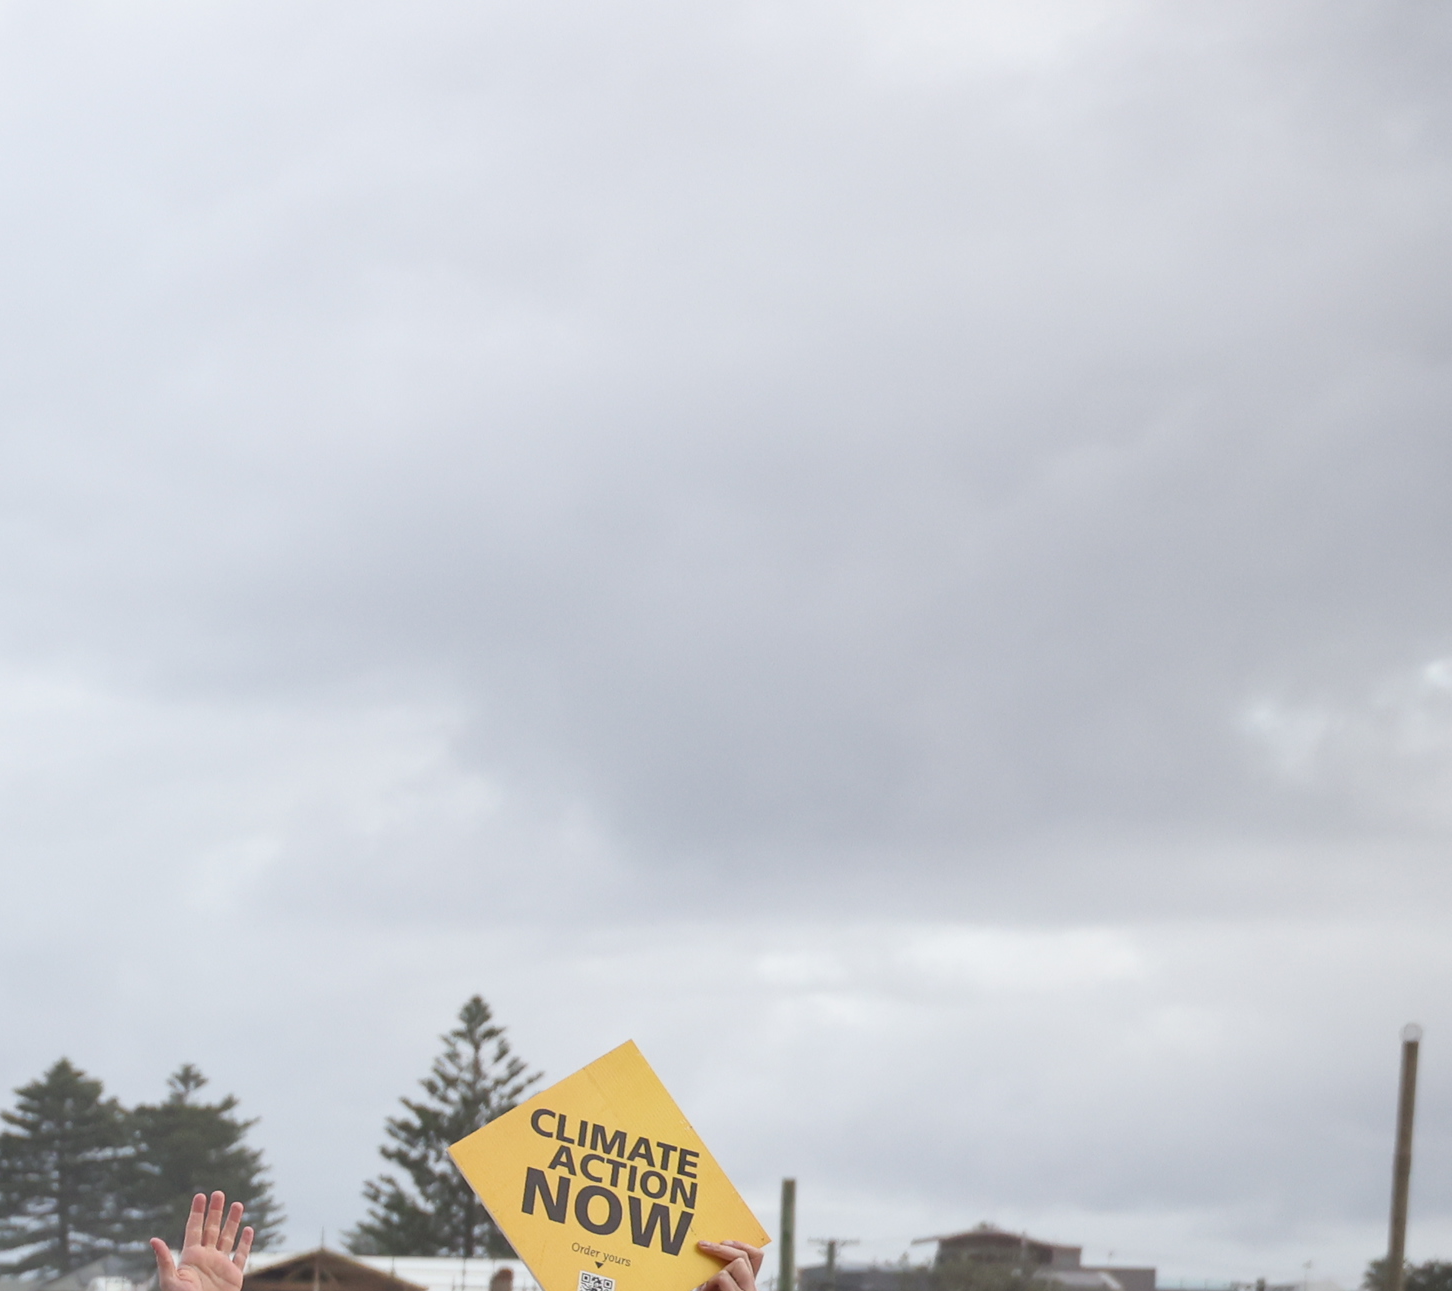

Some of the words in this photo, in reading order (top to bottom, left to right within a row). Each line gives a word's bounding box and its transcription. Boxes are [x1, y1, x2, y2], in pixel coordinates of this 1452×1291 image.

[530, 1108, 700, 1180] CLIMATE
[548, 1144, 698, 1210] ACTION
[521, 1166, 695, 1257] NOW
[571, 1242, 600, 1259] Order
[602, 1251, 631, 1267] yours
